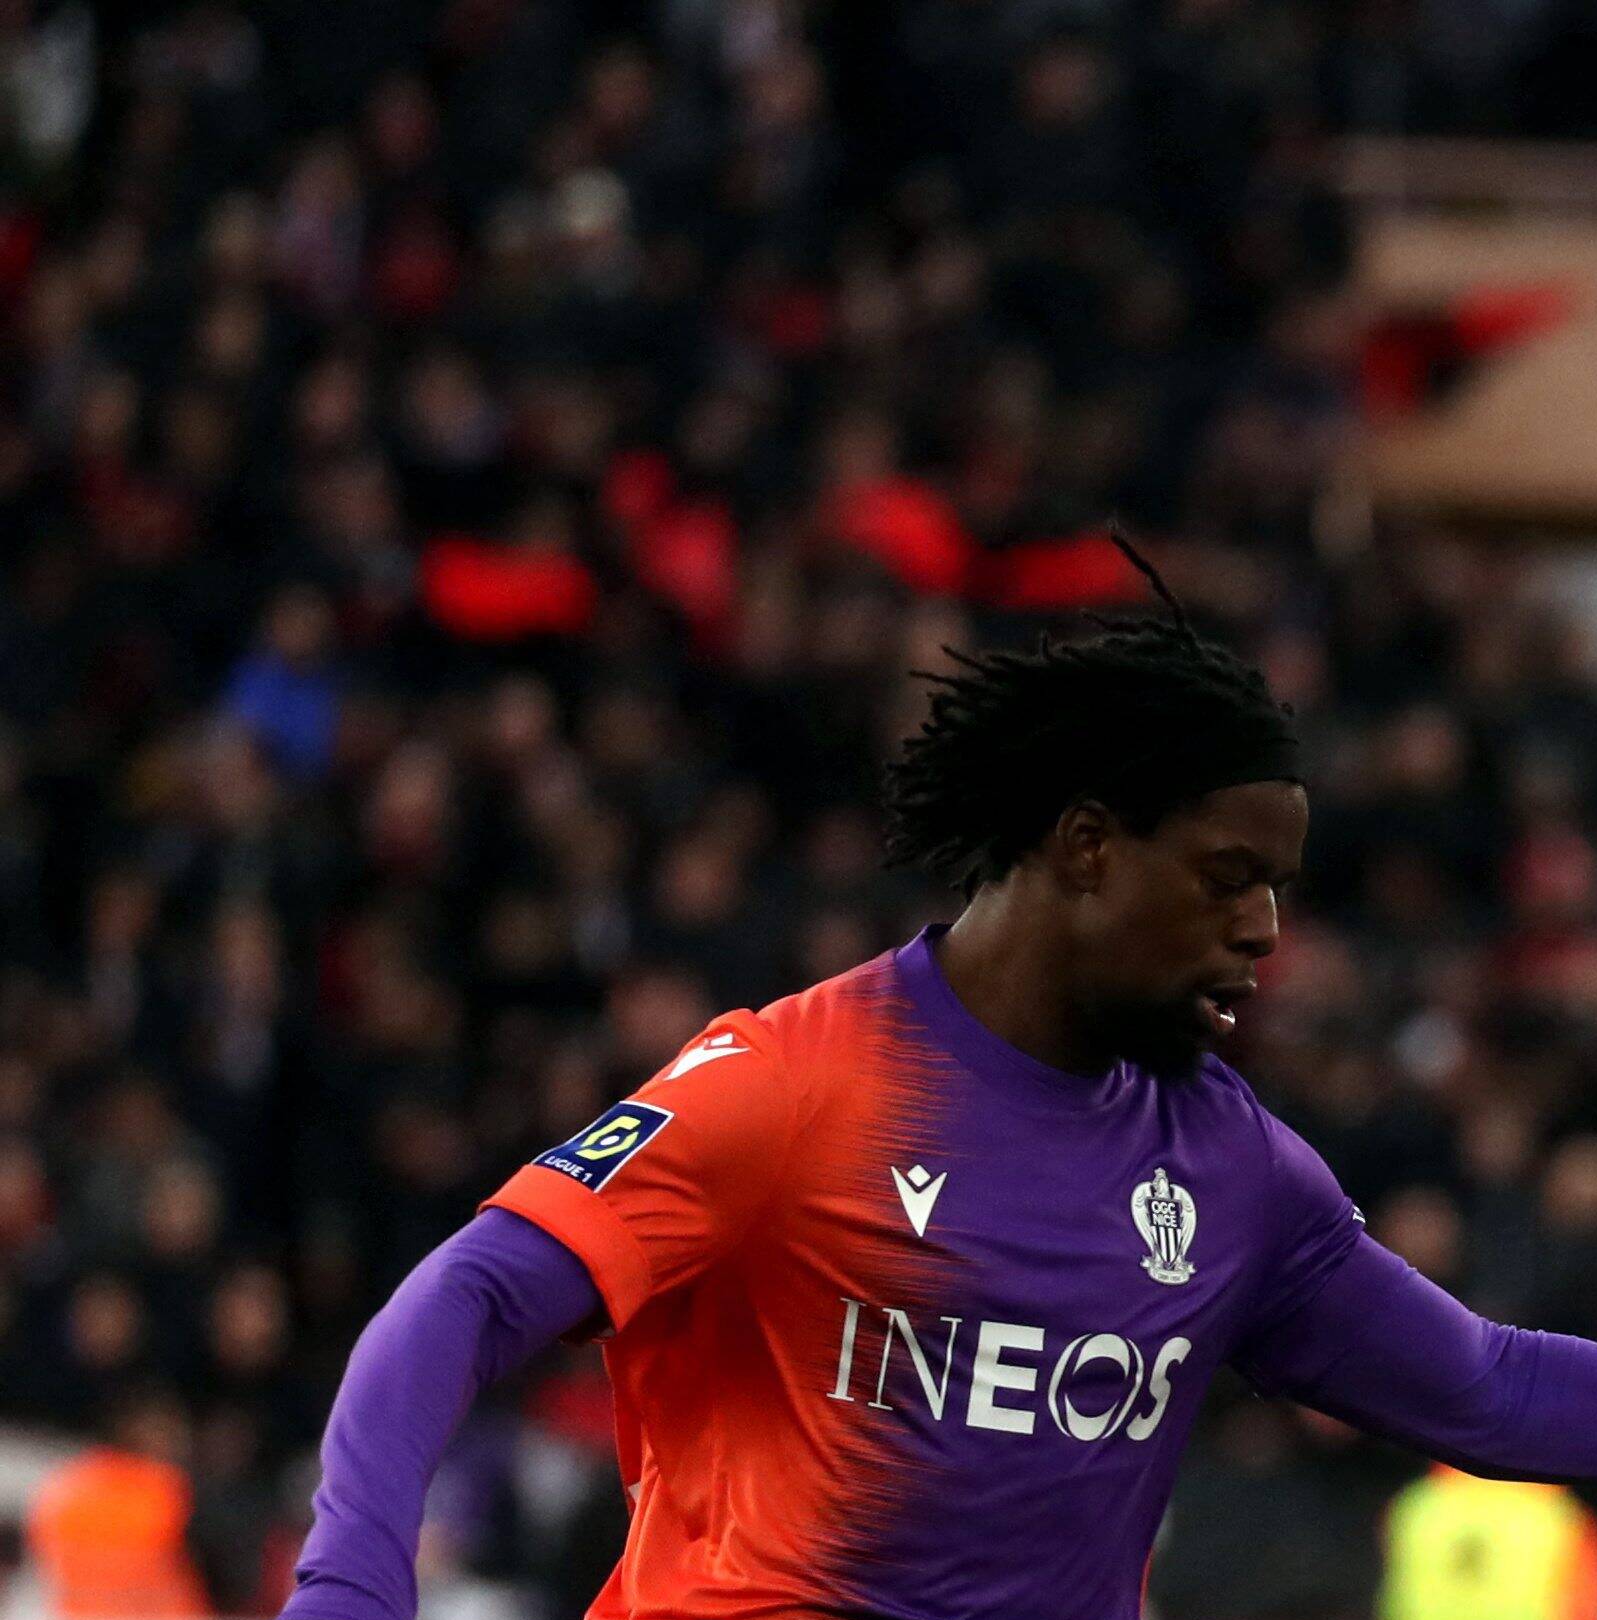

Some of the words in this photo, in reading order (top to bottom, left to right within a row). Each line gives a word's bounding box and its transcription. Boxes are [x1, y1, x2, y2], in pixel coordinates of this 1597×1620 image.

[544, 1155, 585, 1178] LIGUE
[582, 1172, 593, 1183] 1
[1150, 1200, 1177, 1215] OGC
[1152, 1213, 1178, 1228] NICE
[826, 1297, 1193, 1442] INEOS
